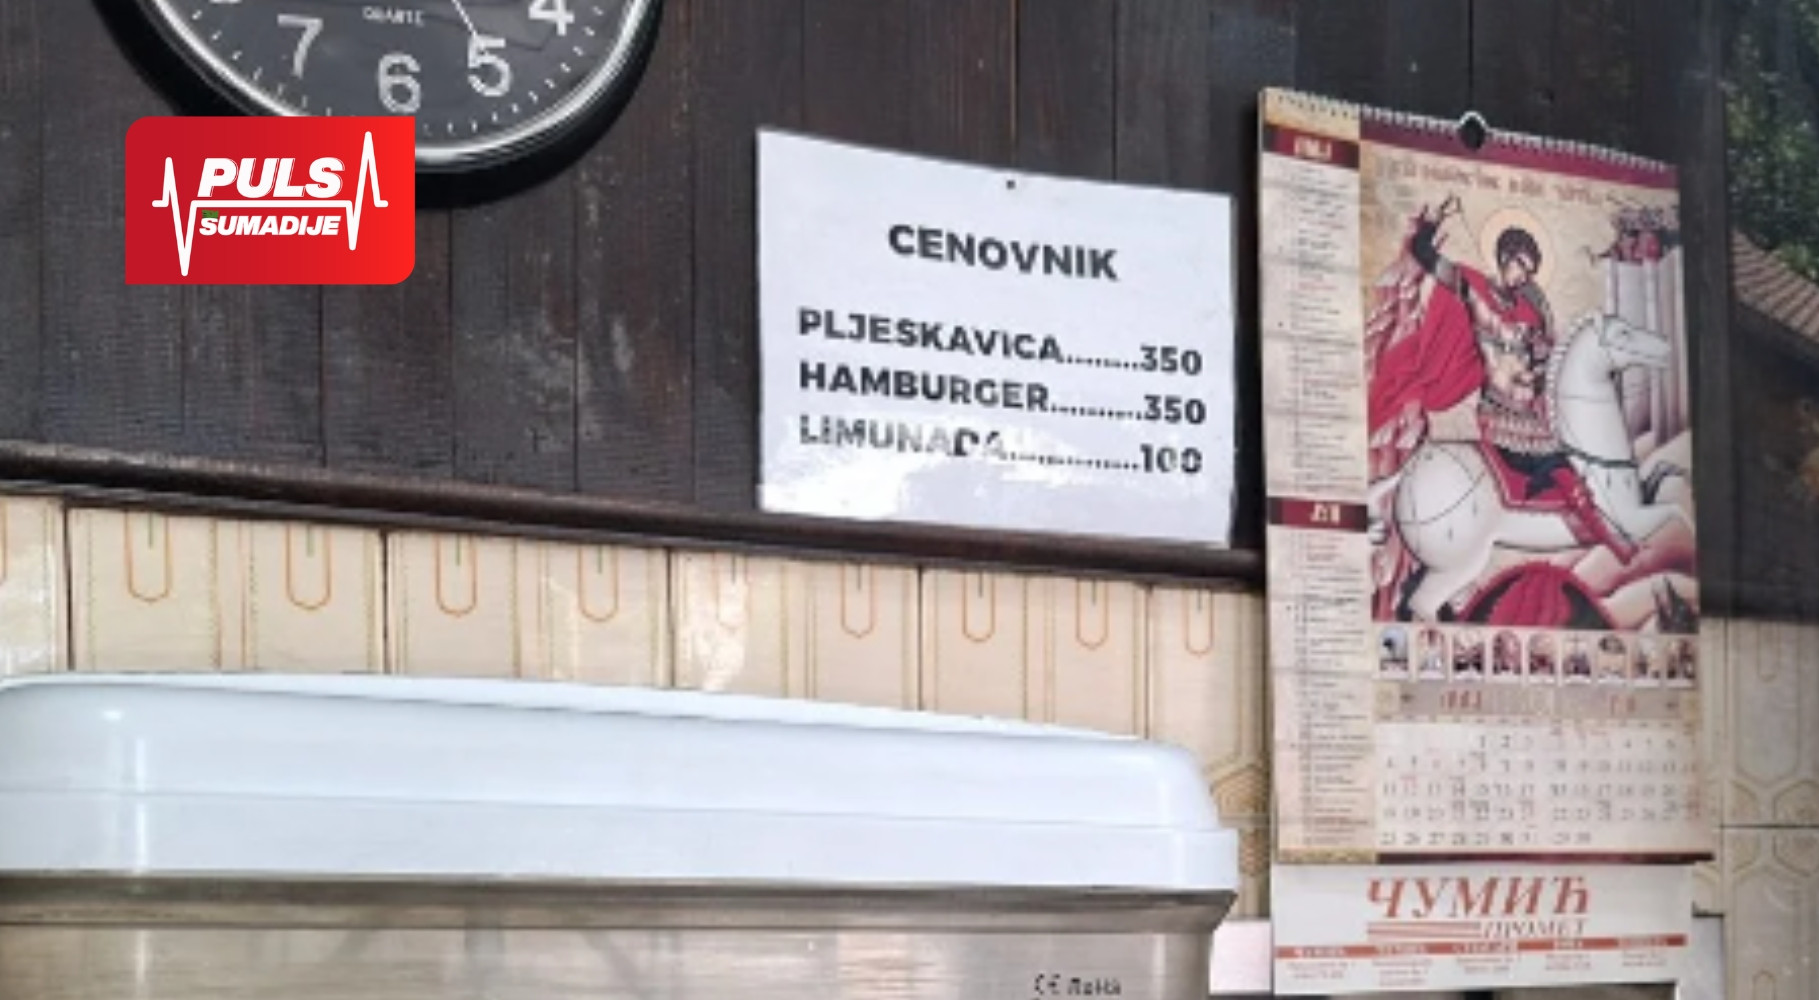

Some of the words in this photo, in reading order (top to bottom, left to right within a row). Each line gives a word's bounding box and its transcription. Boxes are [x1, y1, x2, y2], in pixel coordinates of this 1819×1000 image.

[277, 13, 324, 78] 7
[527, 0, 576, 37] 4
[376, 53, 422, 114] 6
[466, 34, 513, 97] 5
[888, 223, 1120, 283] CENOVNIK
[797, 306, 1061, 364] PLJESKAVICA
[1140, 344, 1203, 376] 350
[798, 360, 1050, 413] HAMBURGER
[1143, 394, 1207, 426] 350
[798, 413, 1007, 461] LIMUNADA
[1140, 443, 1203, 475] 100
[1367, 876, 1590, 919] ЧУМИЋ
